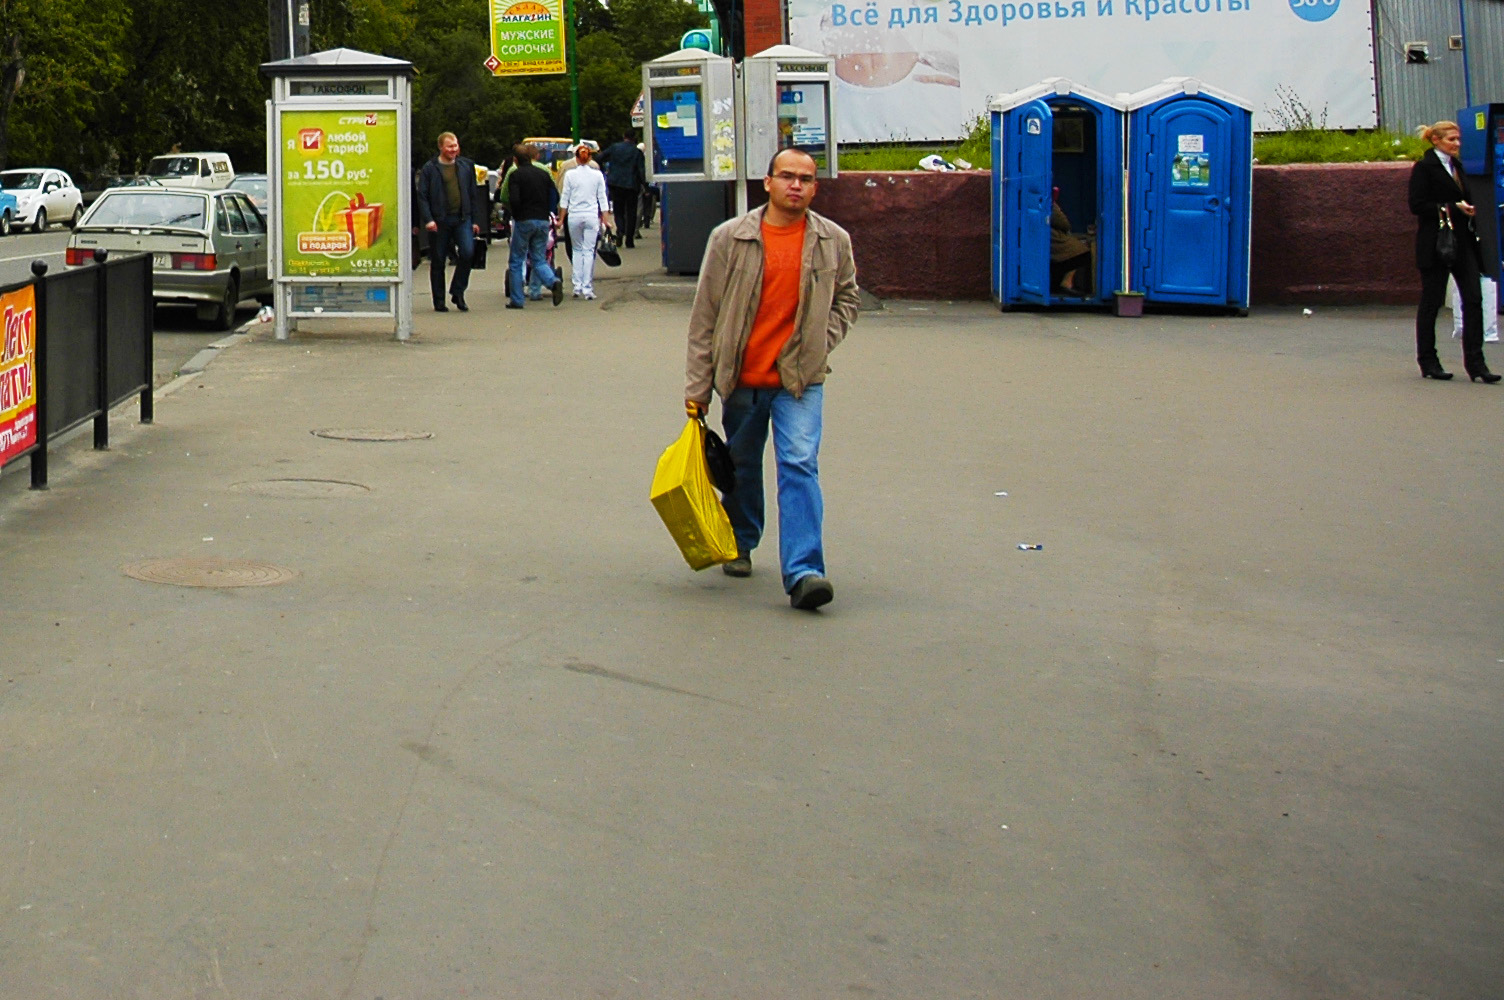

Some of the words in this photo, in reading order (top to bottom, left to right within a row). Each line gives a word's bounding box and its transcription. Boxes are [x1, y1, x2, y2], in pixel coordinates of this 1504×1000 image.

[831, 2, 879, 26] Всё
[888, 6, 938, 29] для
[948, 0, 1086, 27] Здоровья
[1097, 0, 1113, 16] и
[501, 29, 554, 41] МУЖСКИЕ
[501, 43, 554, 55] СОРОЧКИ
[312, 84, 366, 93] ТАКСОФОН
[328, 131, 366, 142] любой
[328, 143, 369, 155] тариф!
[287, 171, 300, 179] за
[303, 160, 344, 179] 150
